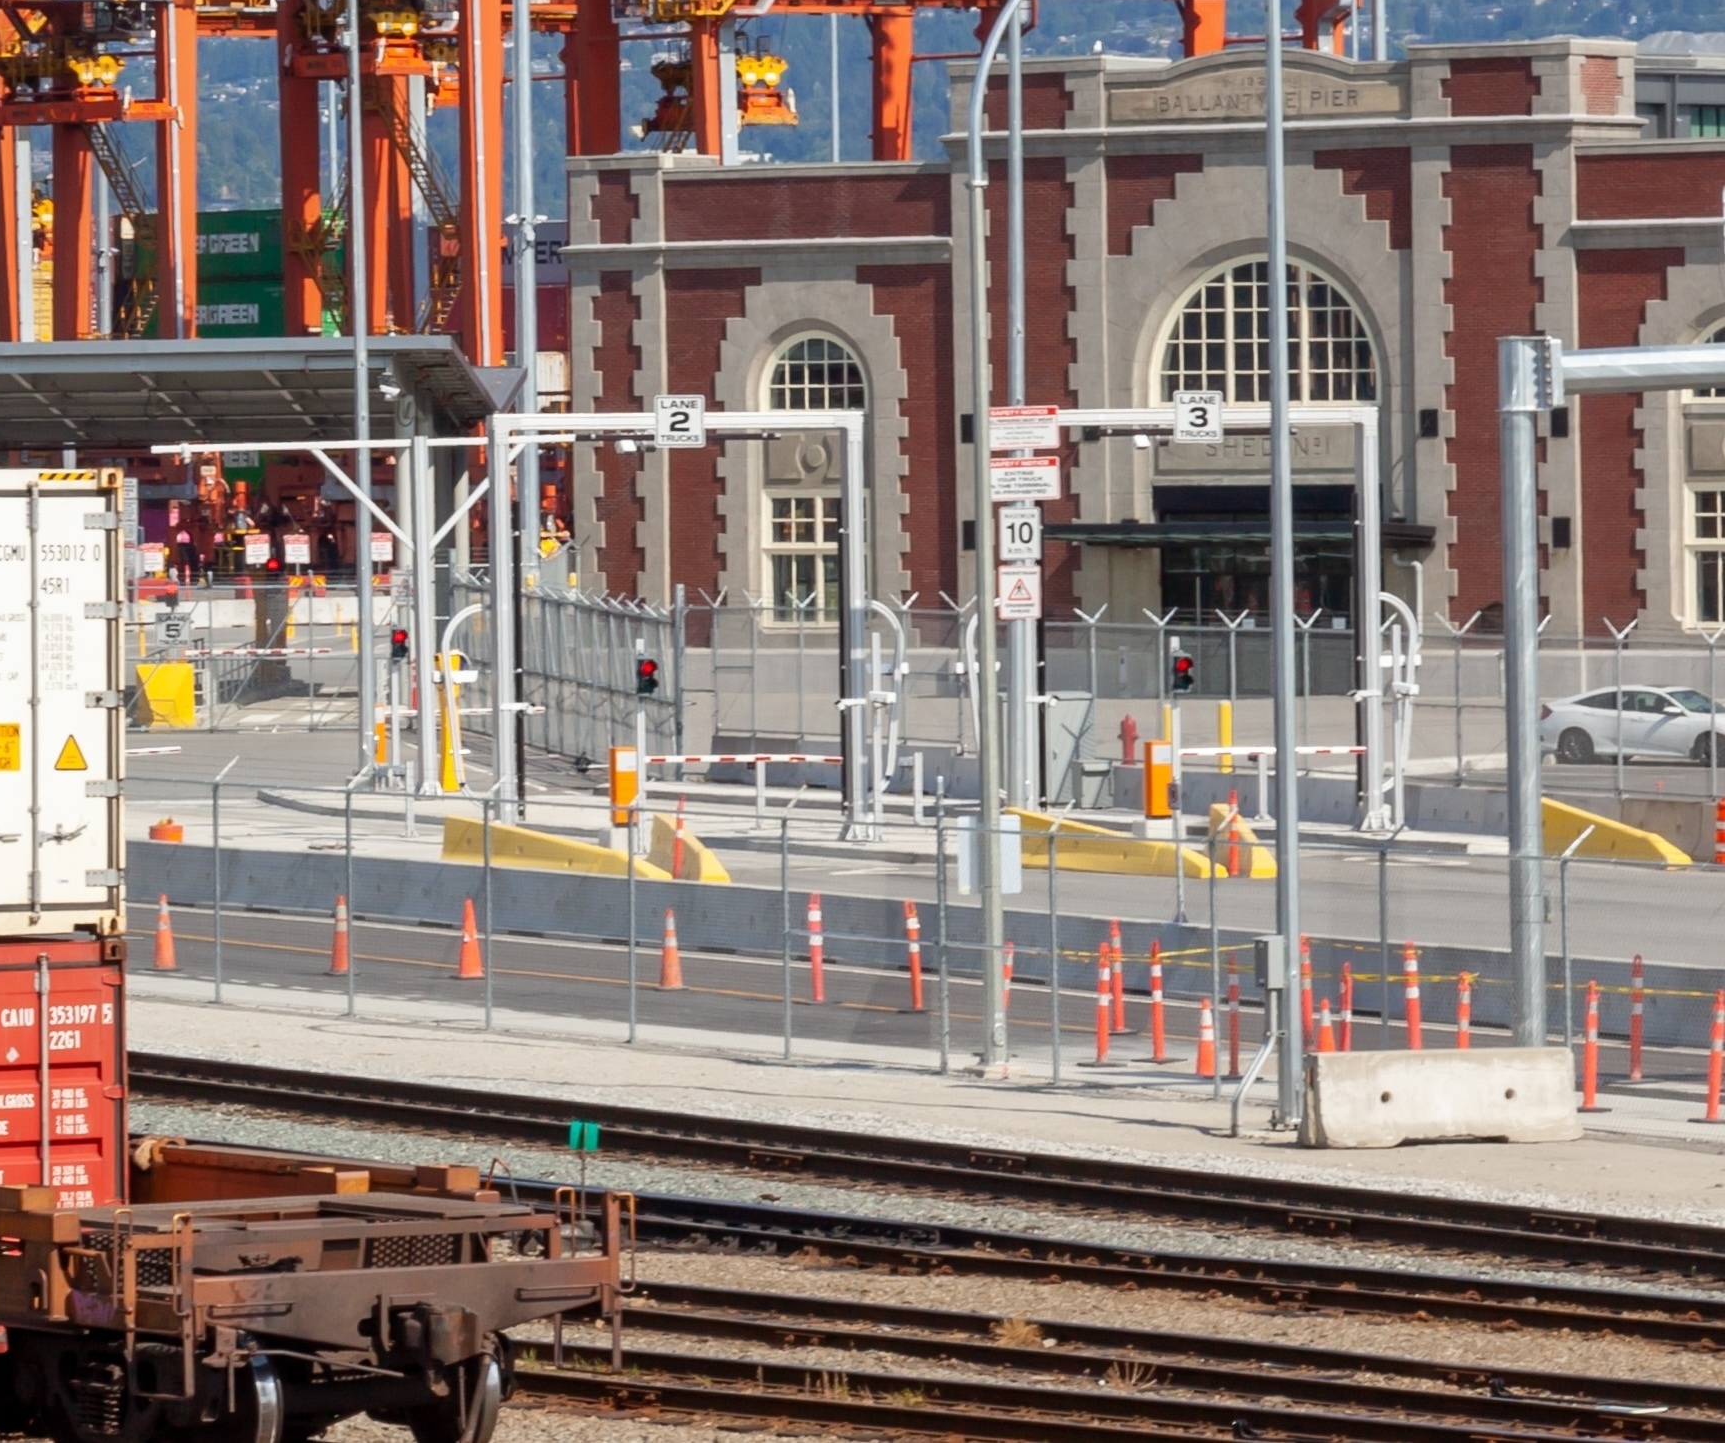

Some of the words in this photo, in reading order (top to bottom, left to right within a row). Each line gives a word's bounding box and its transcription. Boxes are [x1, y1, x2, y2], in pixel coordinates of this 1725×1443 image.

[1158, 92, 1298, 114] BALLANTYE
[1311, 89, 1360, 109] PIER
[660, 399, 699, 410] LANE
[1179, 395, 1217, 406] LANE
[669, 411, 691, 433] 2
[1188, 407, 1208, 428] 3
[660, 434, 700, 443] TRUCKS
[1179, 429, 1218, 439] TRUCKS
[1006, 521, 1034, 544] 10
[40, 543, 87, 562] 553012
[92, 543, 102, 562] 0
[40, 577, 70, 595] 45R1
[164, 622, 182, 639] 5
[0, 1007, 35, 1028] CAIU
[48, 1004, 97, 1027] 353197
[101, 1002, 114, 1026] 5
[48, 1029, 82, 1051] 22G1
